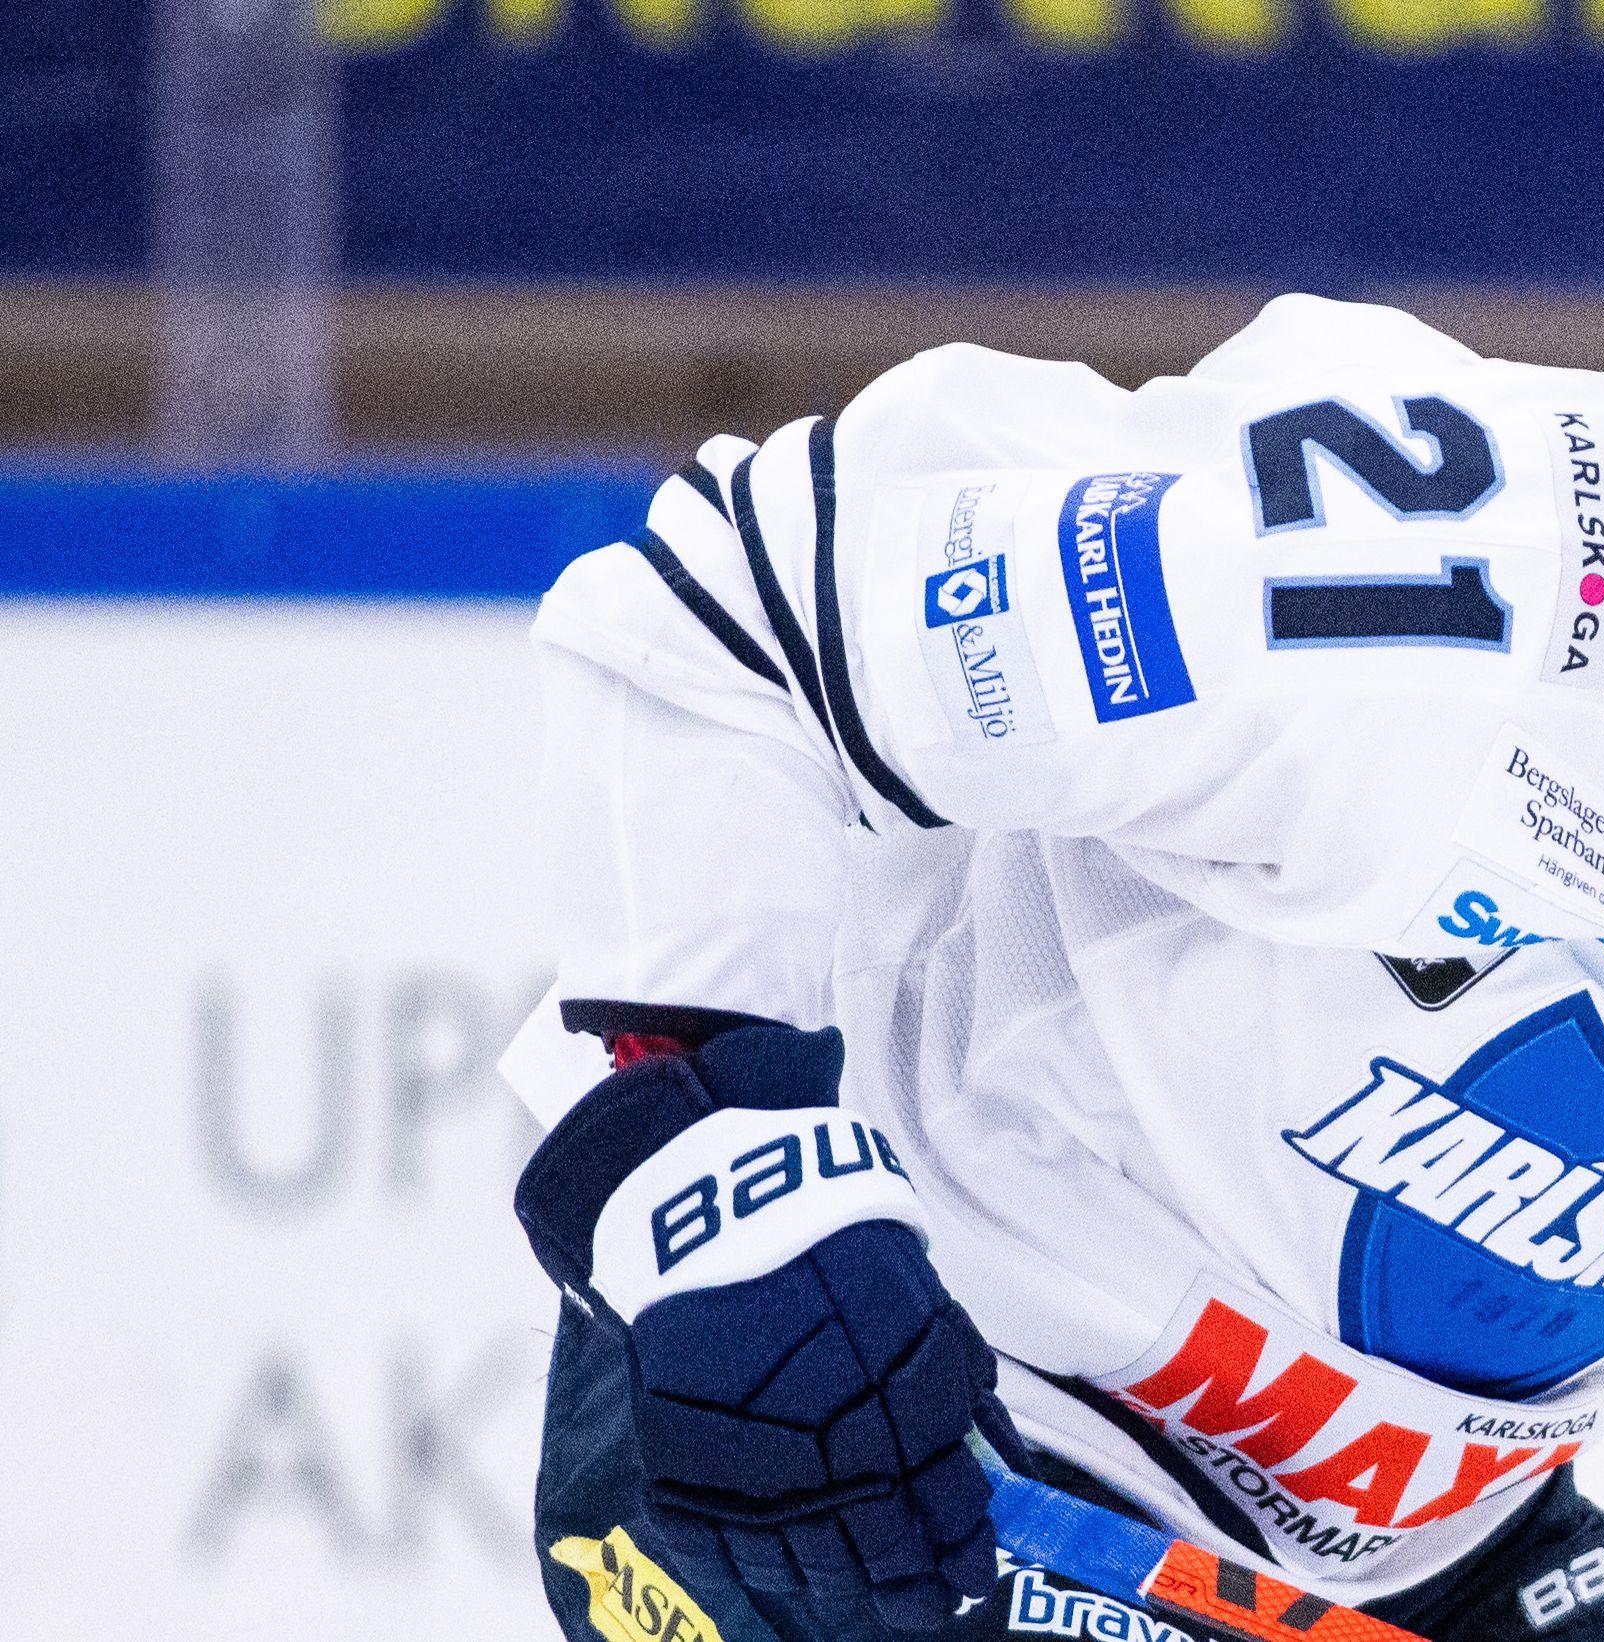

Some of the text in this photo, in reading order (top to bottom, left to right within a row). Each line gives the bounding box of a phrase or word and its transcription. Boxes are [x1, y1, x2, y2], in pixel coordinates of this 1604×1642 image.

[944, 483, 997, 567] Energi
[1075, 502, 1114, 584] KARL
[1240, 393, 1514, 654] 21
[1086, 586, 1138, 705] HEDIN
[964, 645, 1017, 739] Miljö
[1537, 854, 1599, 900] Hängiven
[1455, 1409, 1599, 1442] KARLSKOGA
